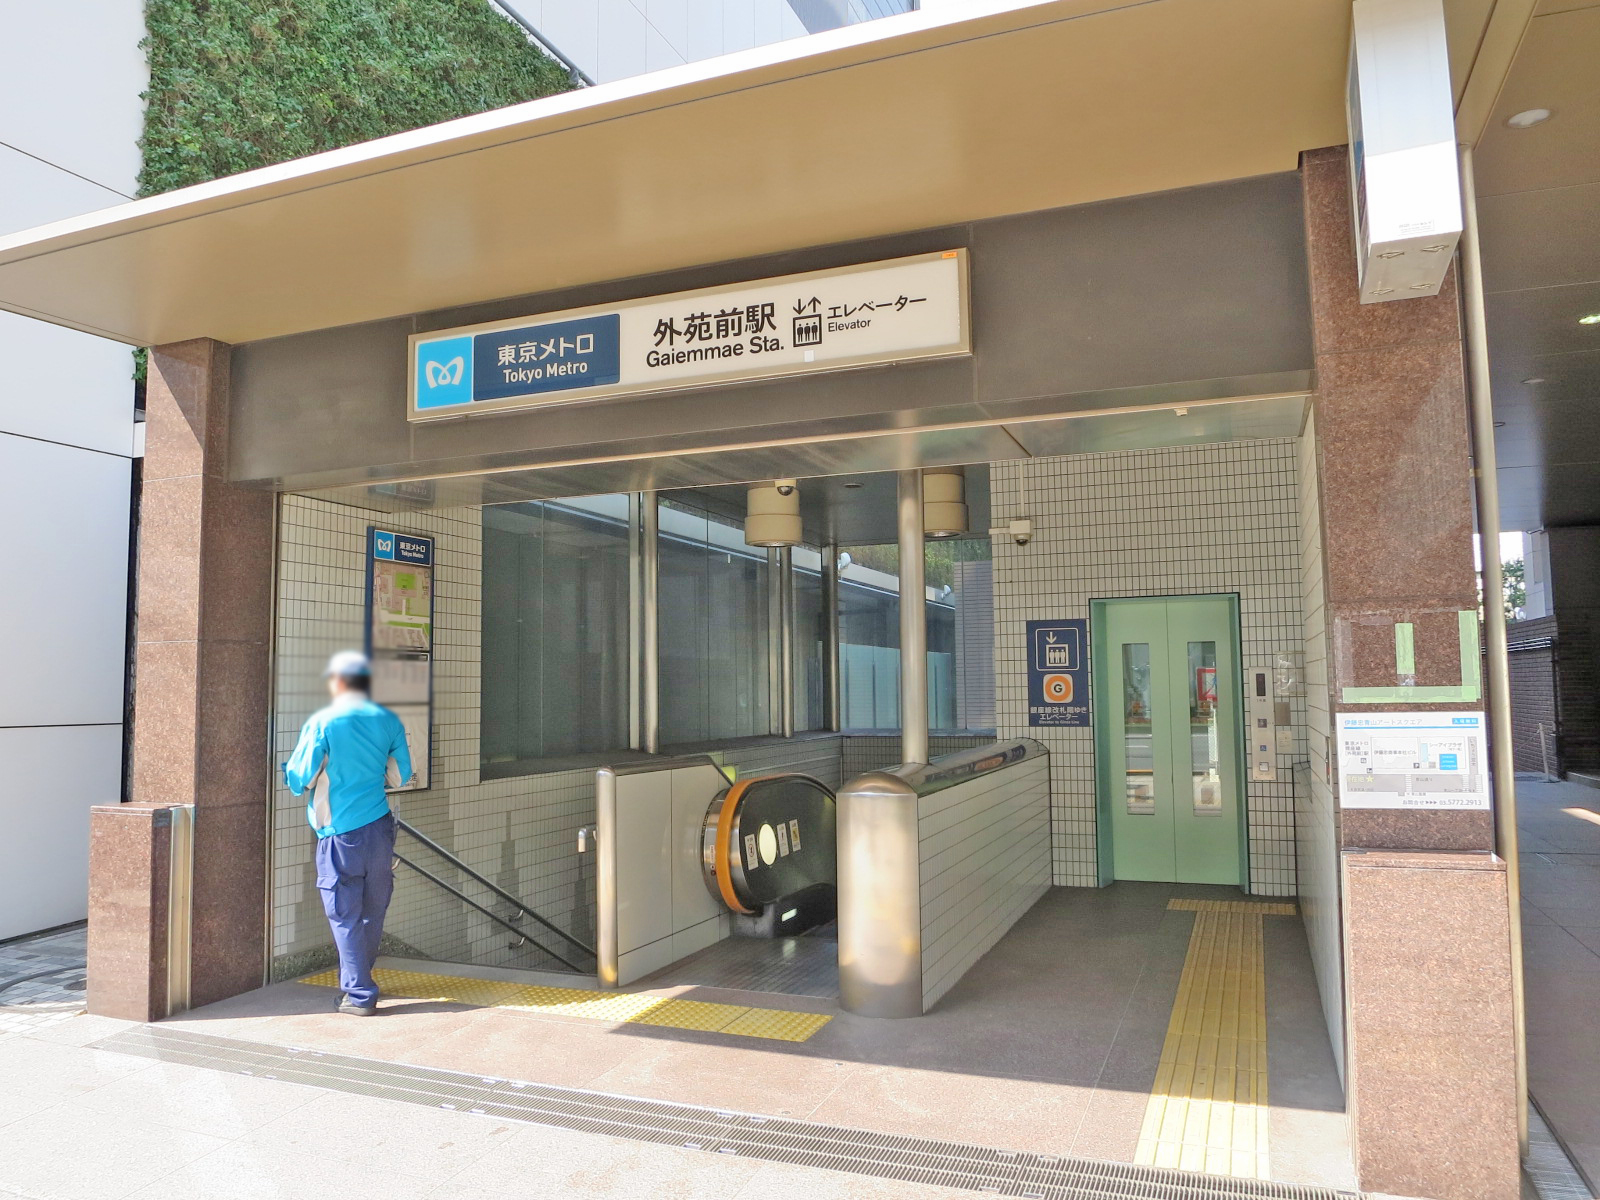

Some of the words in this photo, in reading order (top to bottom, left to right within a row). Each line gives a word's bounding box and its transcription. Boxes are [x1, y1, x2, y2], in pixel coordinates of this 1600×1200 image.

[827, 295, 927, 319] エレベーター
[653, 302, 777, 347] 外苑前駅
[828, 319, 872, 333] Elevator
[497, 333, 594, 367] 東京メトロ
[646, 342, 744, 368] Gaiemmae
[749, 335, 785, 354] Sta.
[503, 367, 543, 384] Tokyo
[546, 361, 588, 378] Metro
[1054, 684, 1062, 693] G
